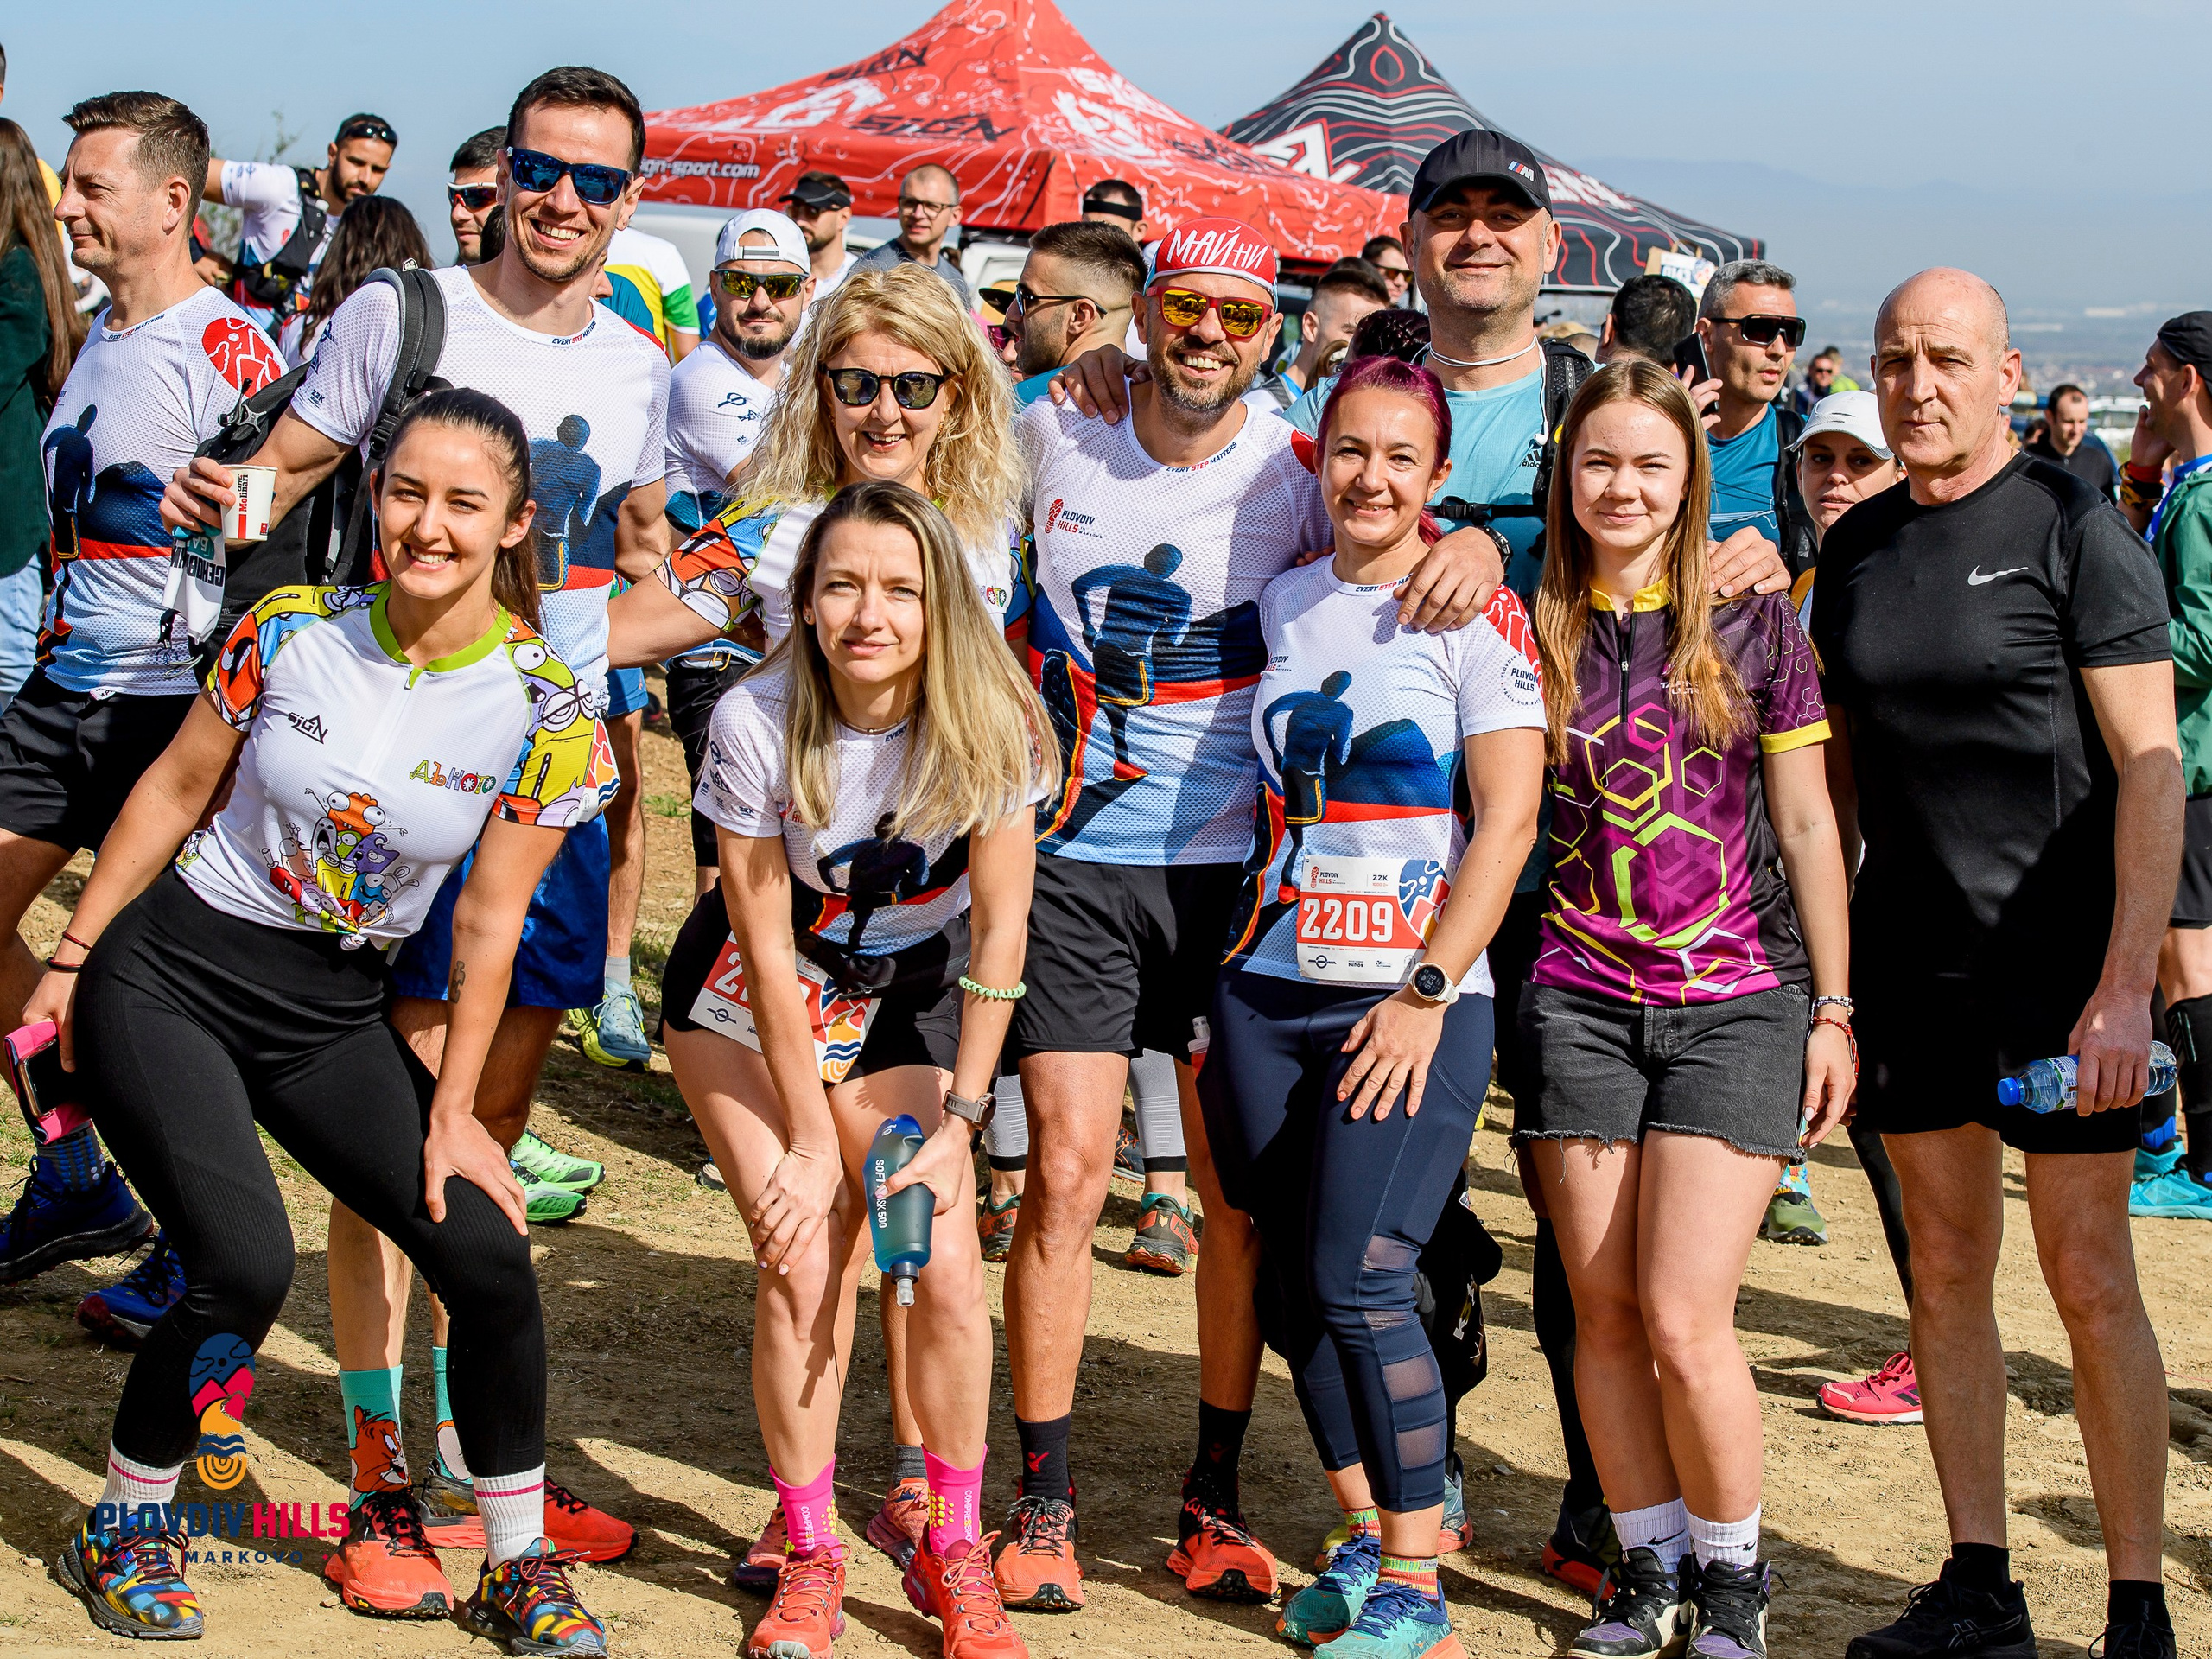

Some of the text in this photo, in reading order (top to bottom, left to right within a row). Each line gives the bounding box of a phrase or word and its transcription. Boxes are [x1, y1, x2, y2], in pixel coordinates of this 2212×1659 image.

[1192, 460, 1210, 472] STEP
[1210, 441, 1238, 465] MATTERS
[238, 474, 249, 512] Molinari
[1061, 510, 1096, 525] PLOVDIV
[1057, 520, 1079, 533] HILLS
[1379, 582, 1398, 590] STEP
[1514, 679, 1535, 692] HILLS
[1300, 898, 1394, 943] 2209
[878, 1211, 887, 1229] 500
